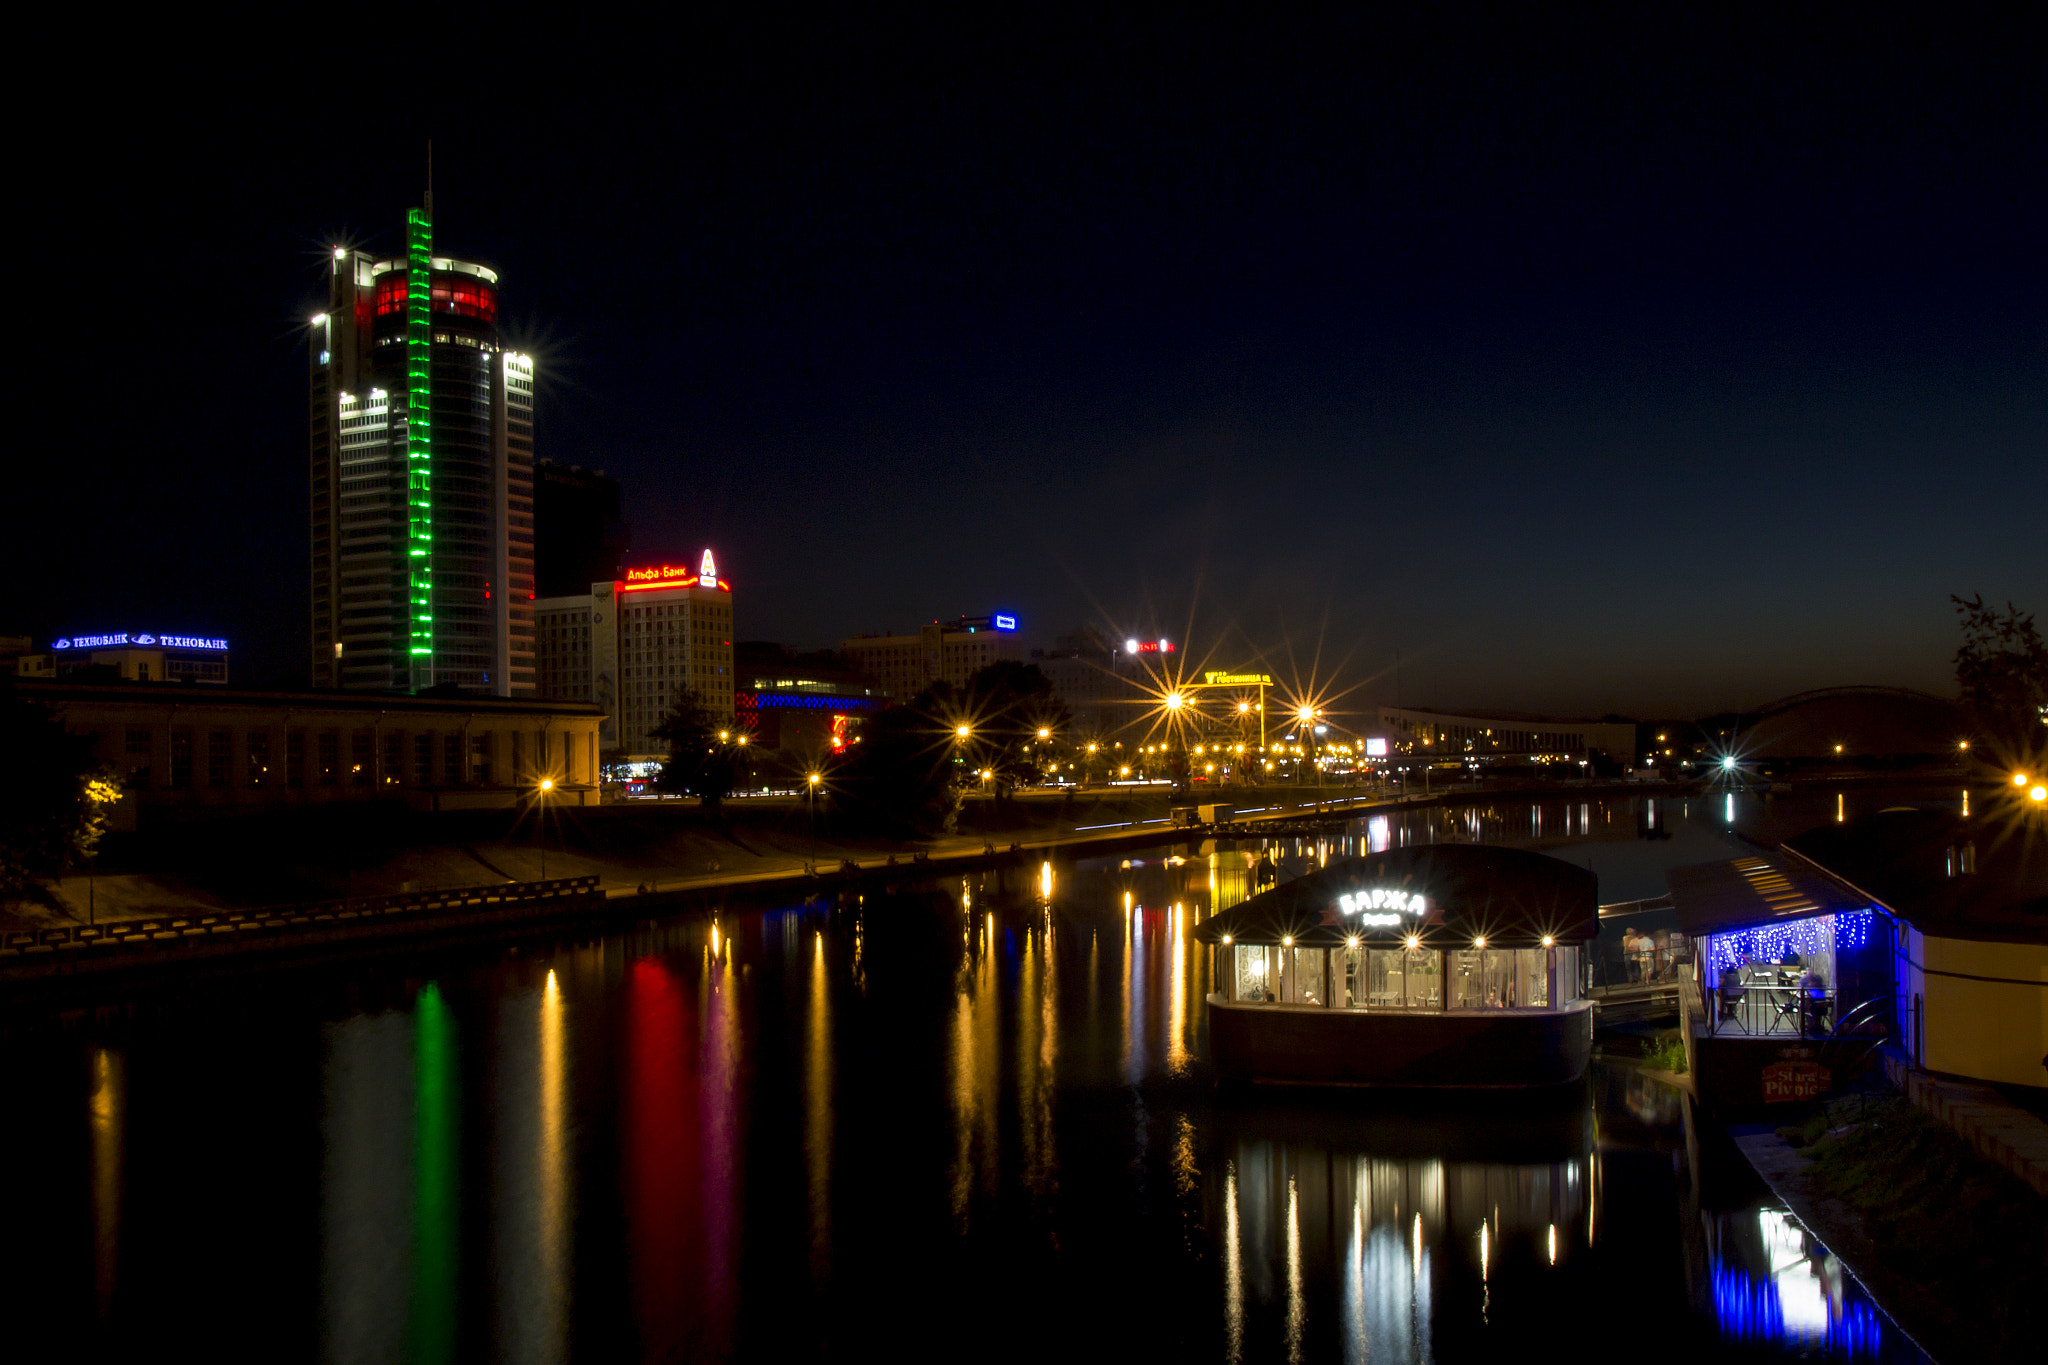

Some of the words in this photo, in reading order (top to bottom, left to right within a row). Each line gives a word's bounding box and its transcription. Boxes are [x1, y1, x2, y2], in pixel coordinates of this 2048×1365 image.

[73, 634, 128, 648] ТЕХНОБАНК
[160, 636, 228, 650] ТЕХНОБАНК
[1340, 890, 1425, 915] БАРЖА
